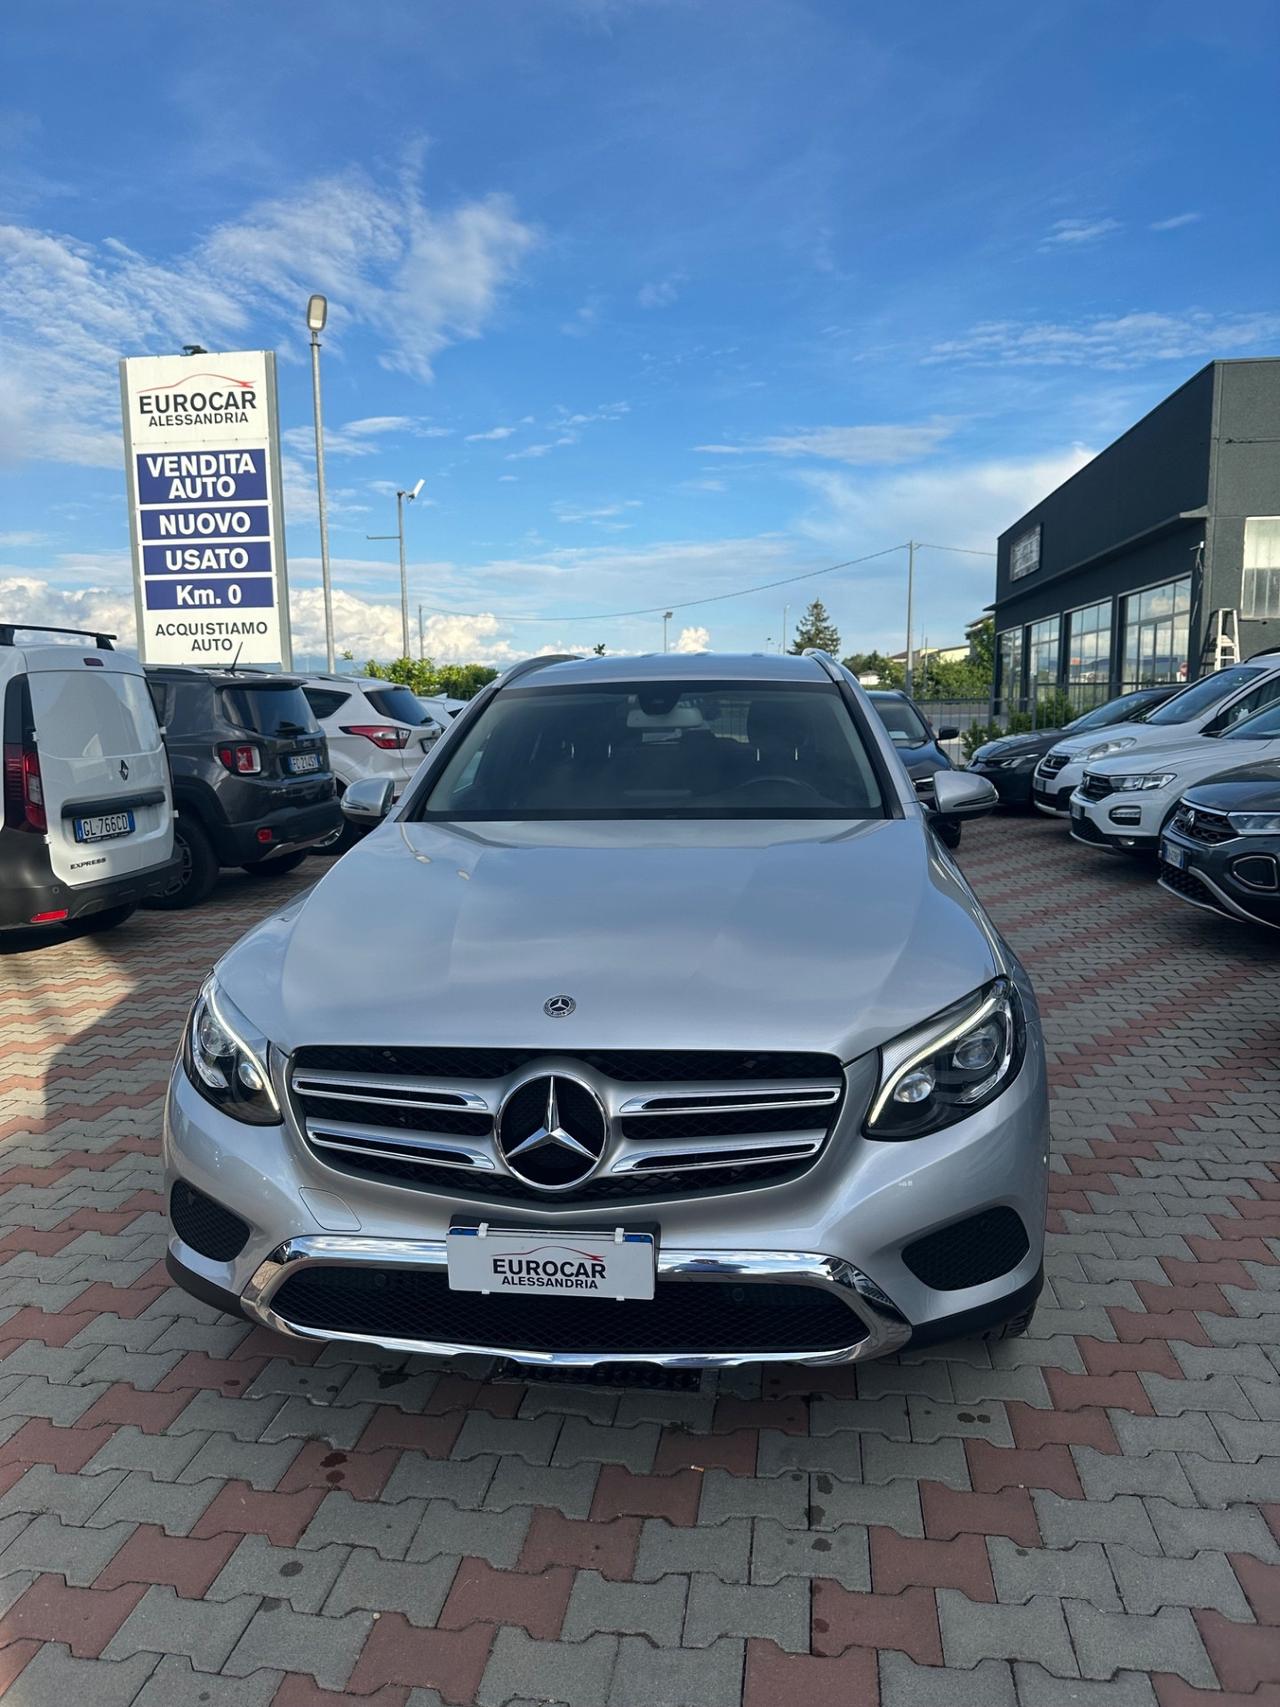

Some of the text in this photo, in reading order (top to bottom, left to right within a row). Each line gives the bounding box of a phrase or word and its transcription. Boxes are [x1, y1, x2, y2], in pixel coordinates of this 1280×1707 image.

[139, 390, 257, 415] EUROCAR
[148, 412, 249, 428] ALESSANDRIA
[146, 453, 256, 478] VENDITA
[168, 476, 236, 500] AUTO
[158, 511, 251, 535] NUOVO
[165, 548, 249, 571] USATO
[176, 584, 242, 606] Km. 0
[155, 621, 268, 637] ACQUISTIAMO
[191, 638, 233, 652] AUTO
[82, 820, 97, 837] GL
[98, 814, 128, 834] 766CD
[70, 857, 107, 870] EXPRESS
[492, 1258, 607, 1279] EUROCAR
[501, 1275, 599, 1289] ALESSANDRIA
